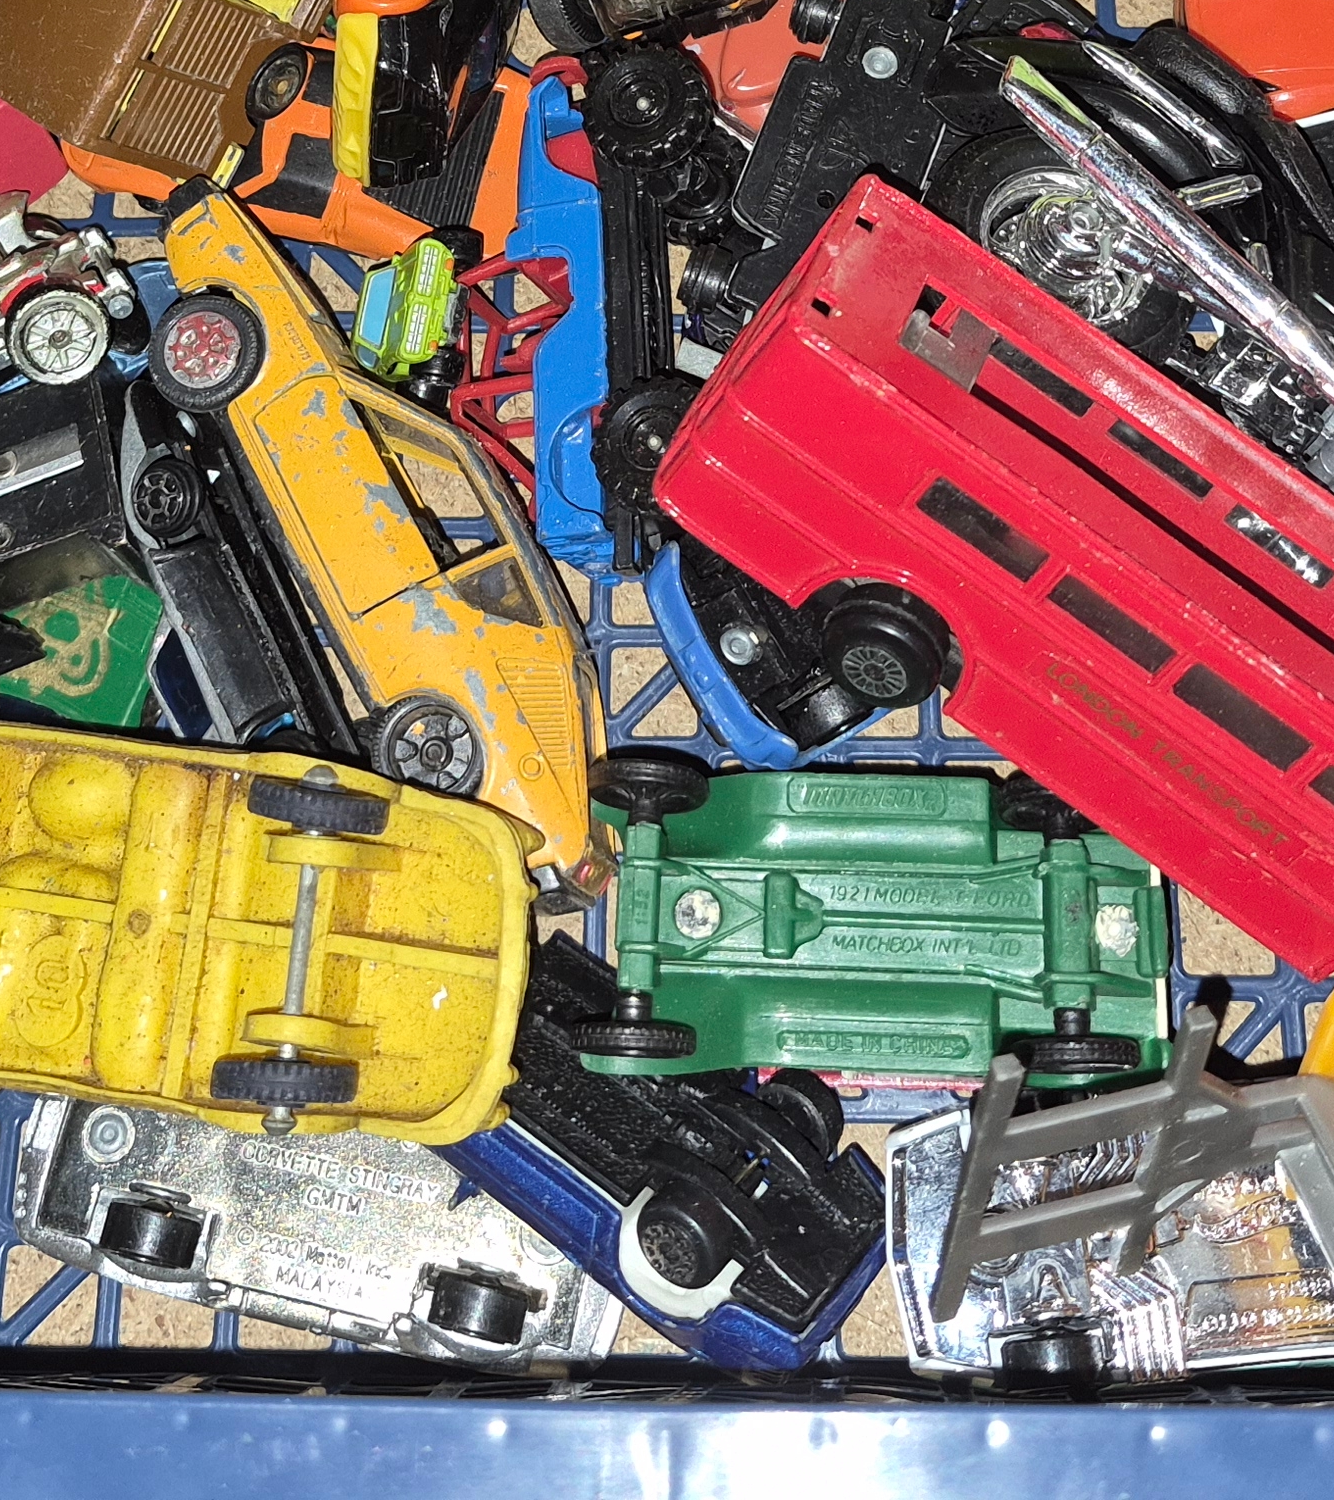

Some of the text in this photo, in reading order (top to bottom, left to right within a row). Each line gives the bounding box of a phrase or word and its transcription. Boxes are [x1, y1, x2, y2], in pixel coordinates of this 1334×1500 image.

[1042, 658, 1289, 849] LONDON TRANSPORT
[831, 934, 924, 953] MATCHBOX
[859, 1034, 881, 1051] IN
[888, 1035, 954, 1054] CHINA
[239, 1140, 442, 1203] CORVETTE STINGRAY
[305, 1186, 364, 1215] GMTM
